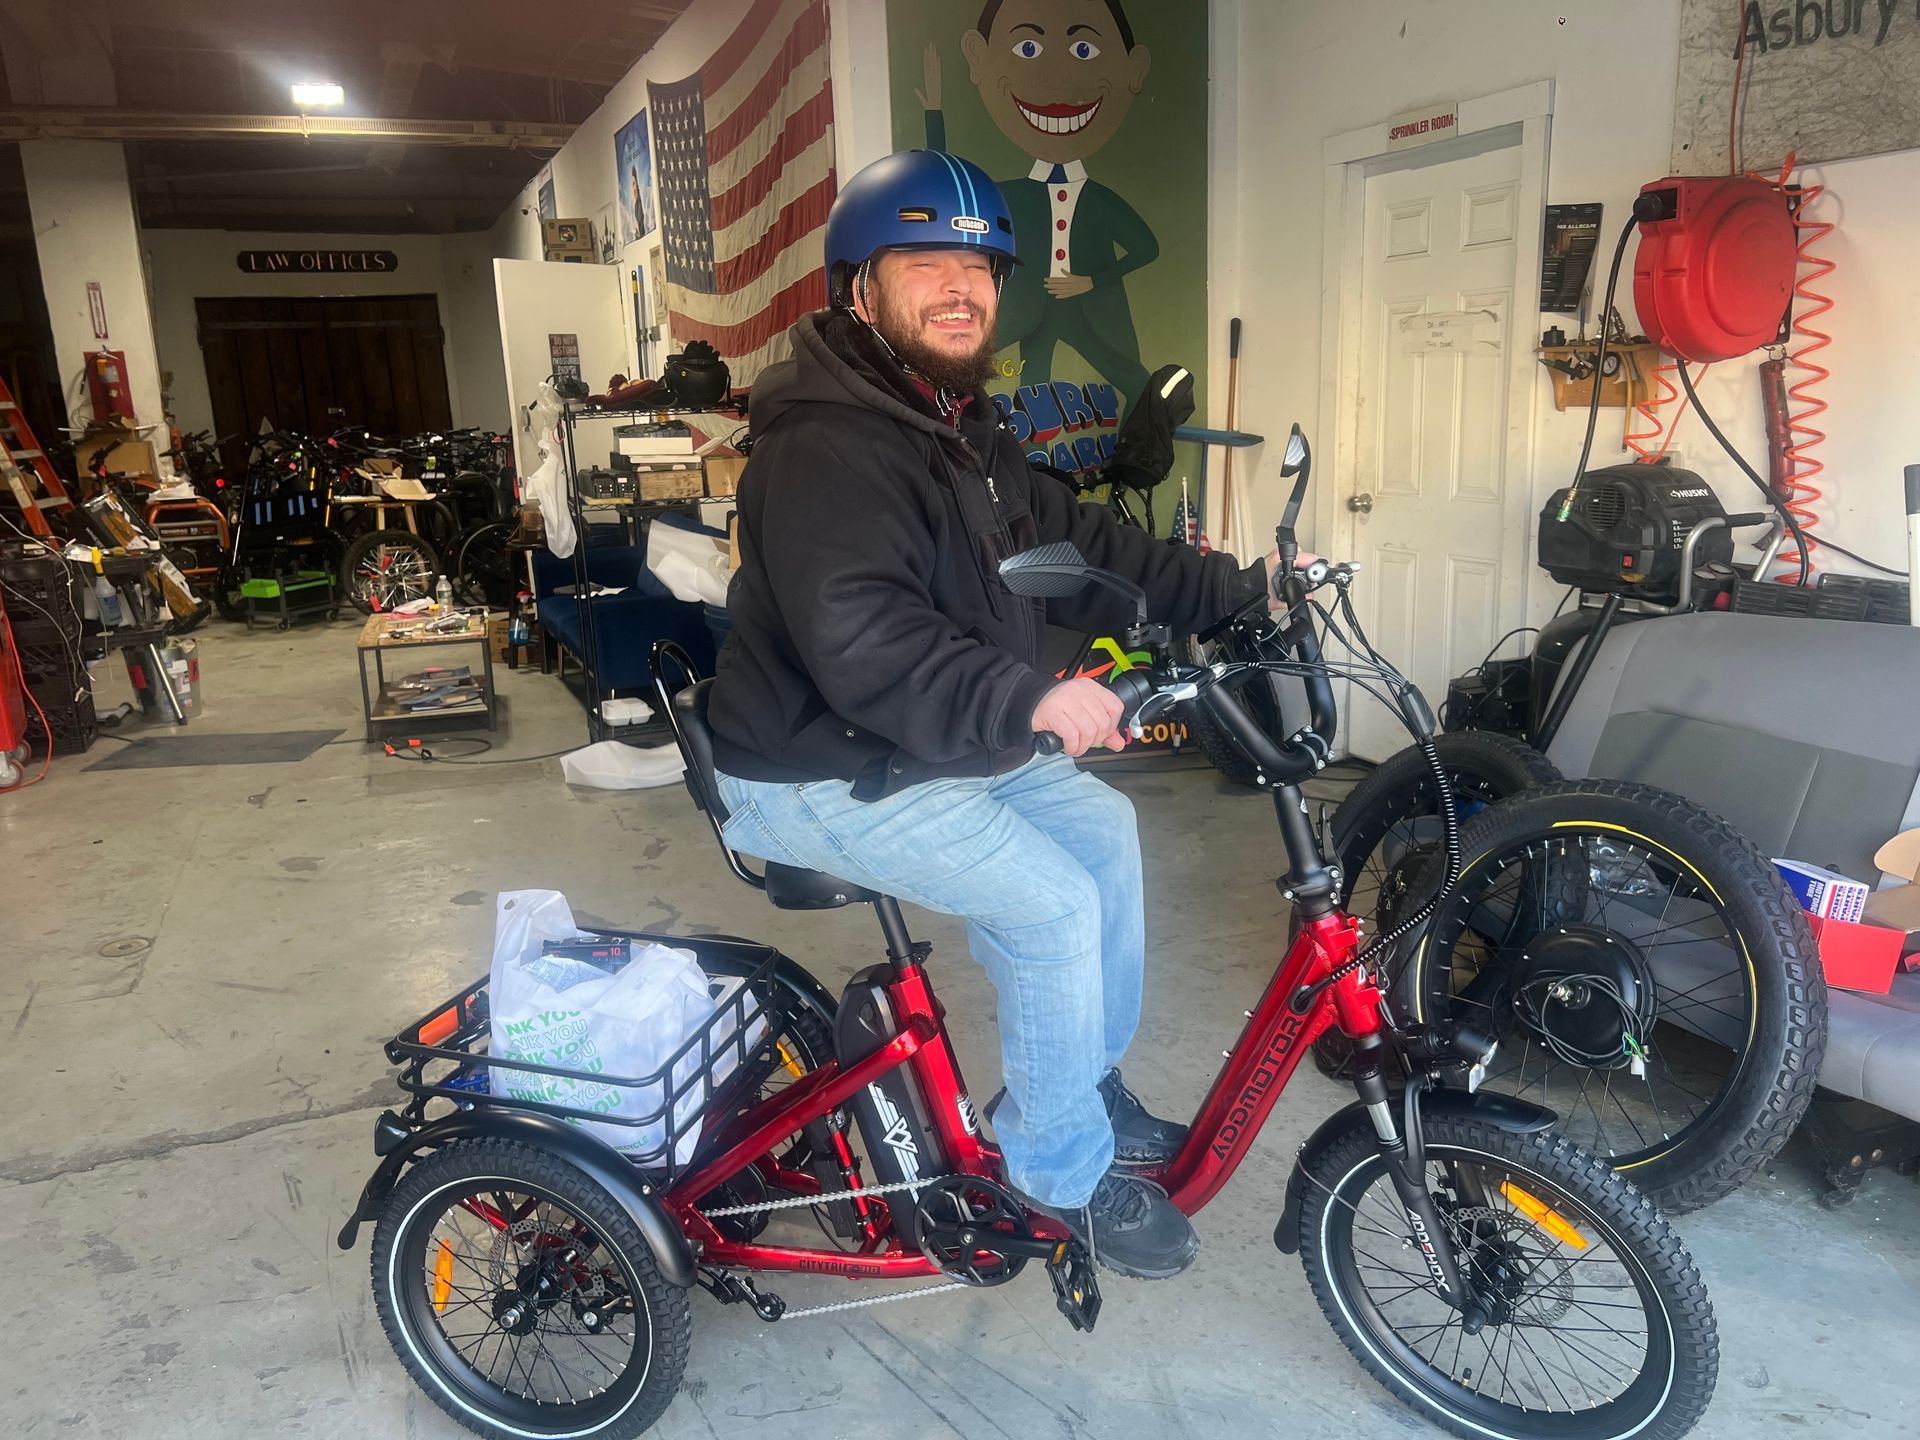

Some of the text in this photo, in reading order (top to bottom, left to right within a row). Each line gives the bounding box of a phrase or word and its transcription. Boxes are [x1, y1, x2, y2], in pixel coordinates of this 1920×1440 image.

[1733, 0, 1898, 60] Asbury
[1391, 113, 1454, 140] SPRINKLER ROOM
[250, 250, 386, 270] LAW OFFICES
[1680, 489, 1709, 497] HUSKY
[1806, 880, 1817, 898] TUBE
[544, 1018, 588, 1045] YOU
[1211, 1015, 1303, 1161] ADDMOTOR
